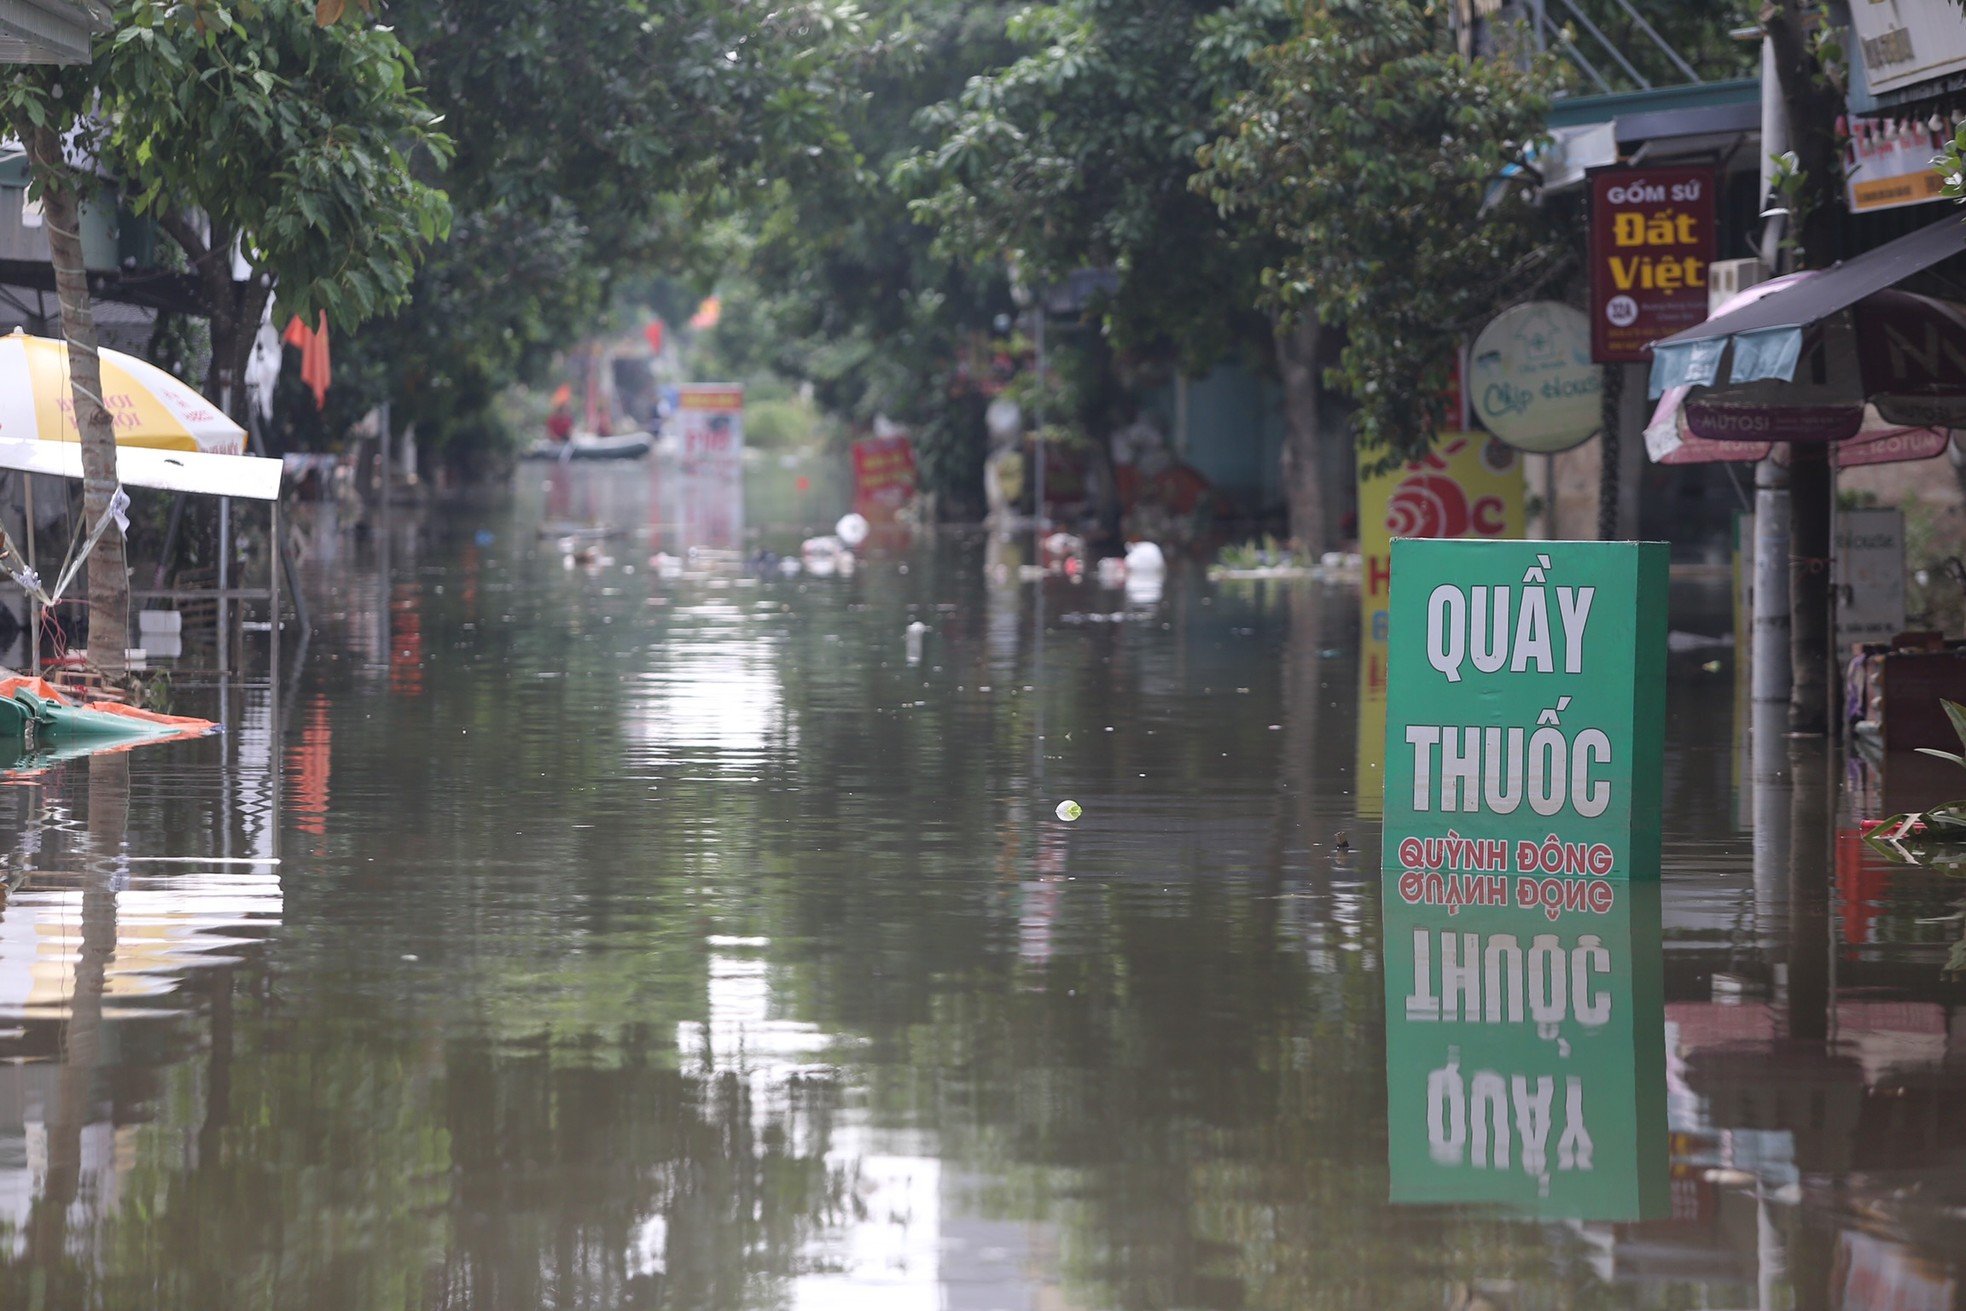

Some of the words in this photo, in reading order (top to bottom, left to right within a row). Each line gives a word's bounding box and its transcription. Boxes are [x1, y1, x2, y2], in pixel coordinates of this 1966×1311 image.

[1607, 178, 1666, 204] GỐM
[1671, 177, 1702, 202] SỨ
[1612, 207, 1698, 247] Đất
[1607, 255, 1705, 295] Việt
[1427, 553, 1596, 683] QUẦY
[1405, 696, 1612, 819] THUỐC
[1398, 829, 1508, 872] QUỲNH
[1516, 833, 1614, 877] ĐÔNG
